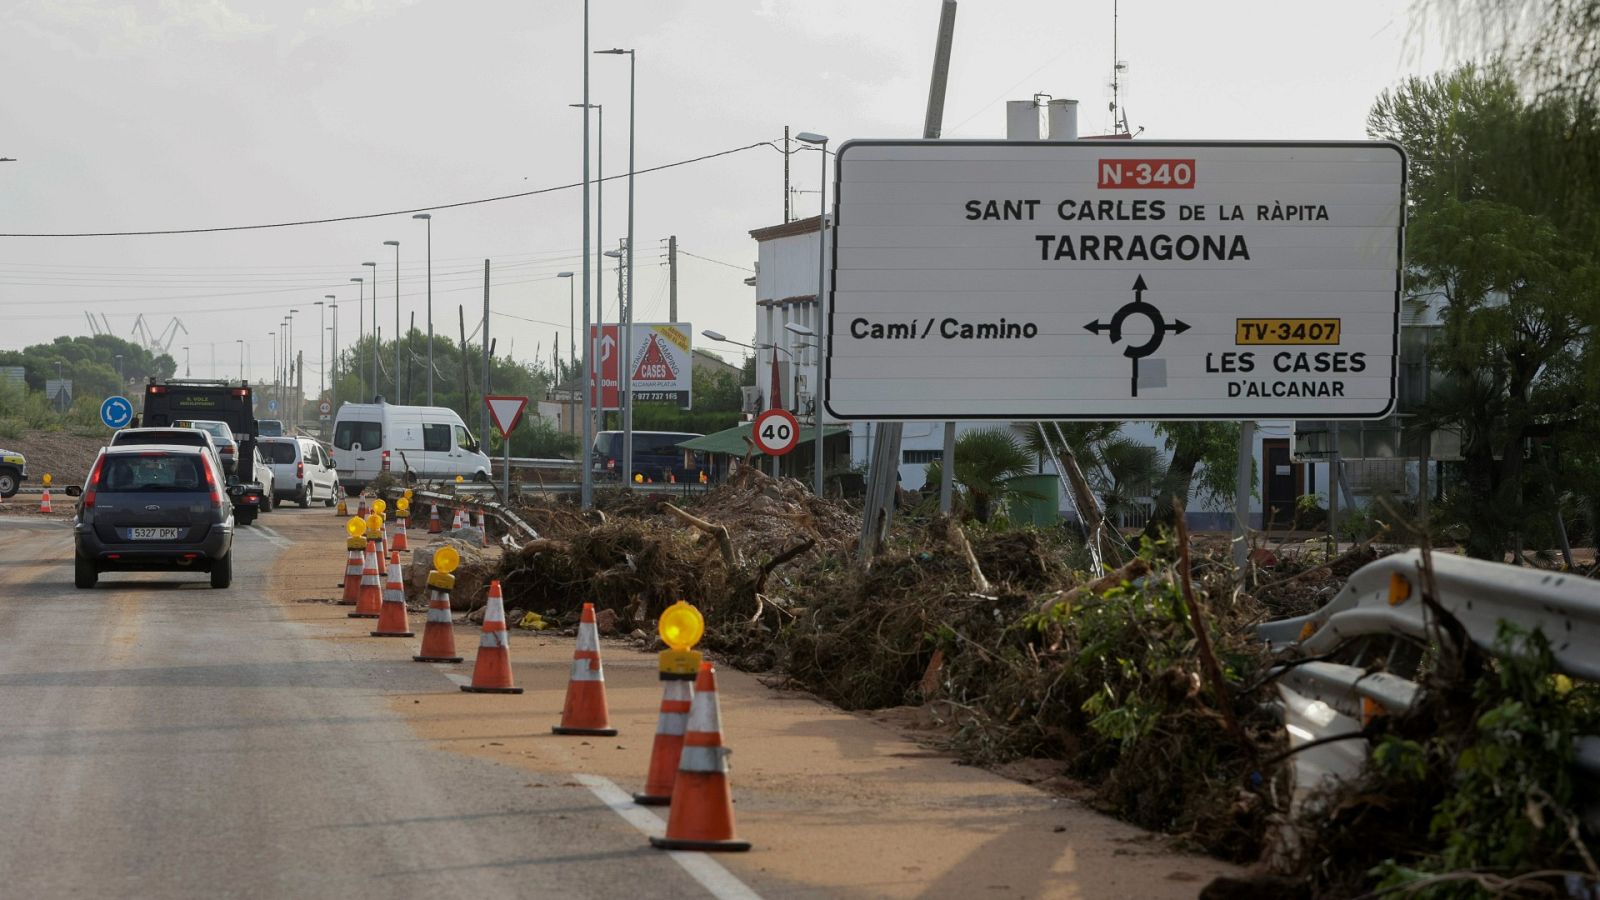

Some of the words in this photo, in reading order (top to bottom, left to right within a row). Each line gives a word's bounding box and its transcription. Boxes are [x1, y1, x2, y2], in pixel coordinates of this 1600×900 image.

[1101, 161, 1193, 185] N-340
[965, 199, 1041, 221] SANT
[1057, 199, 1166, 221] CARLES
[1179, 204, 1206, 221] DE
[1219, 204, 1245, 221] LA
[1257, 200, 1330, 221] RÀPITA
[1035, 234, 1251, 261] TARRAGONA
[1241, 321, 1336, 341] TV-3407
[658, 338, 680, 375] CAMPING
[1205, 352, 1256, 374] LES
[1273, 352, 1367, 374] CASES
[641, 364, 667, 378] CASES
[600, 379, 617, 387] 00m
[1227, 380, 1345, 398] D'ALCANAR
[762, 424, 790, 440] 40
[134, 528, 156, 538] 5327
[159, 528, 176, 538] DPK
